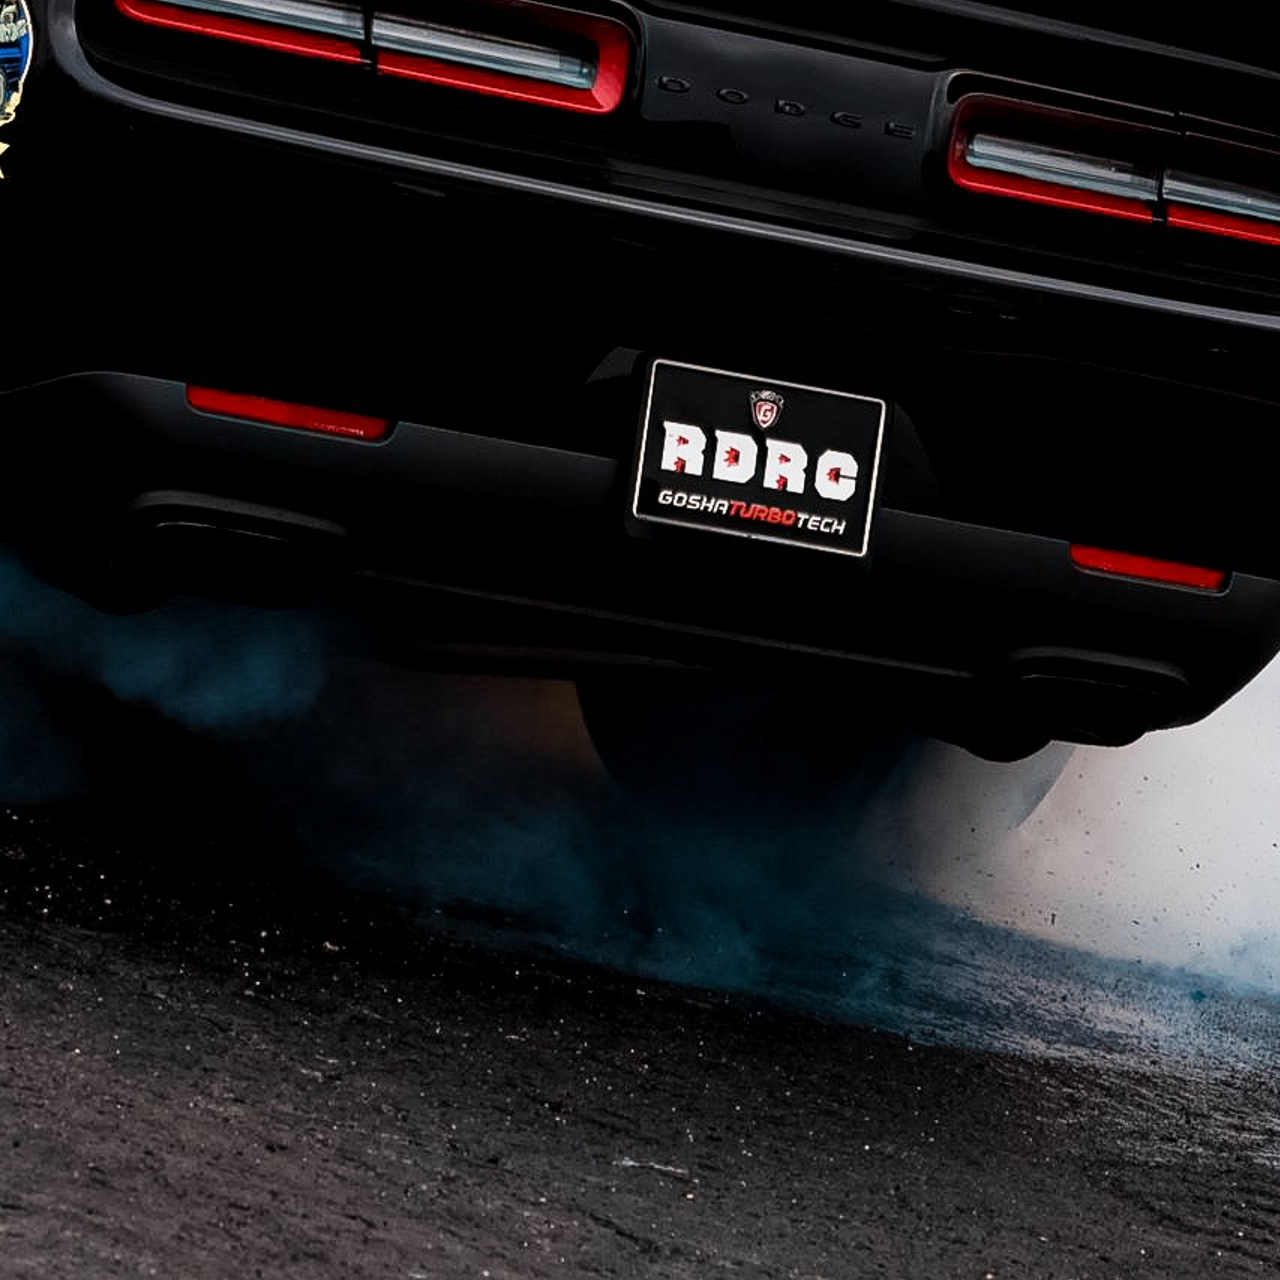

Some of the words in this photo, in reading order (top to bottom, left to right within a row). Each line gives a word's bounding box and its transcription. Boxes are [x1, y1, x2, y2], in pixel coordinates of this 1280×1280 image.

[656, 75, 915, 139] DODGE
[660, 420, 859, 502] RDRC
[657, 489, 847, 536] GOSHATURBOTECH
